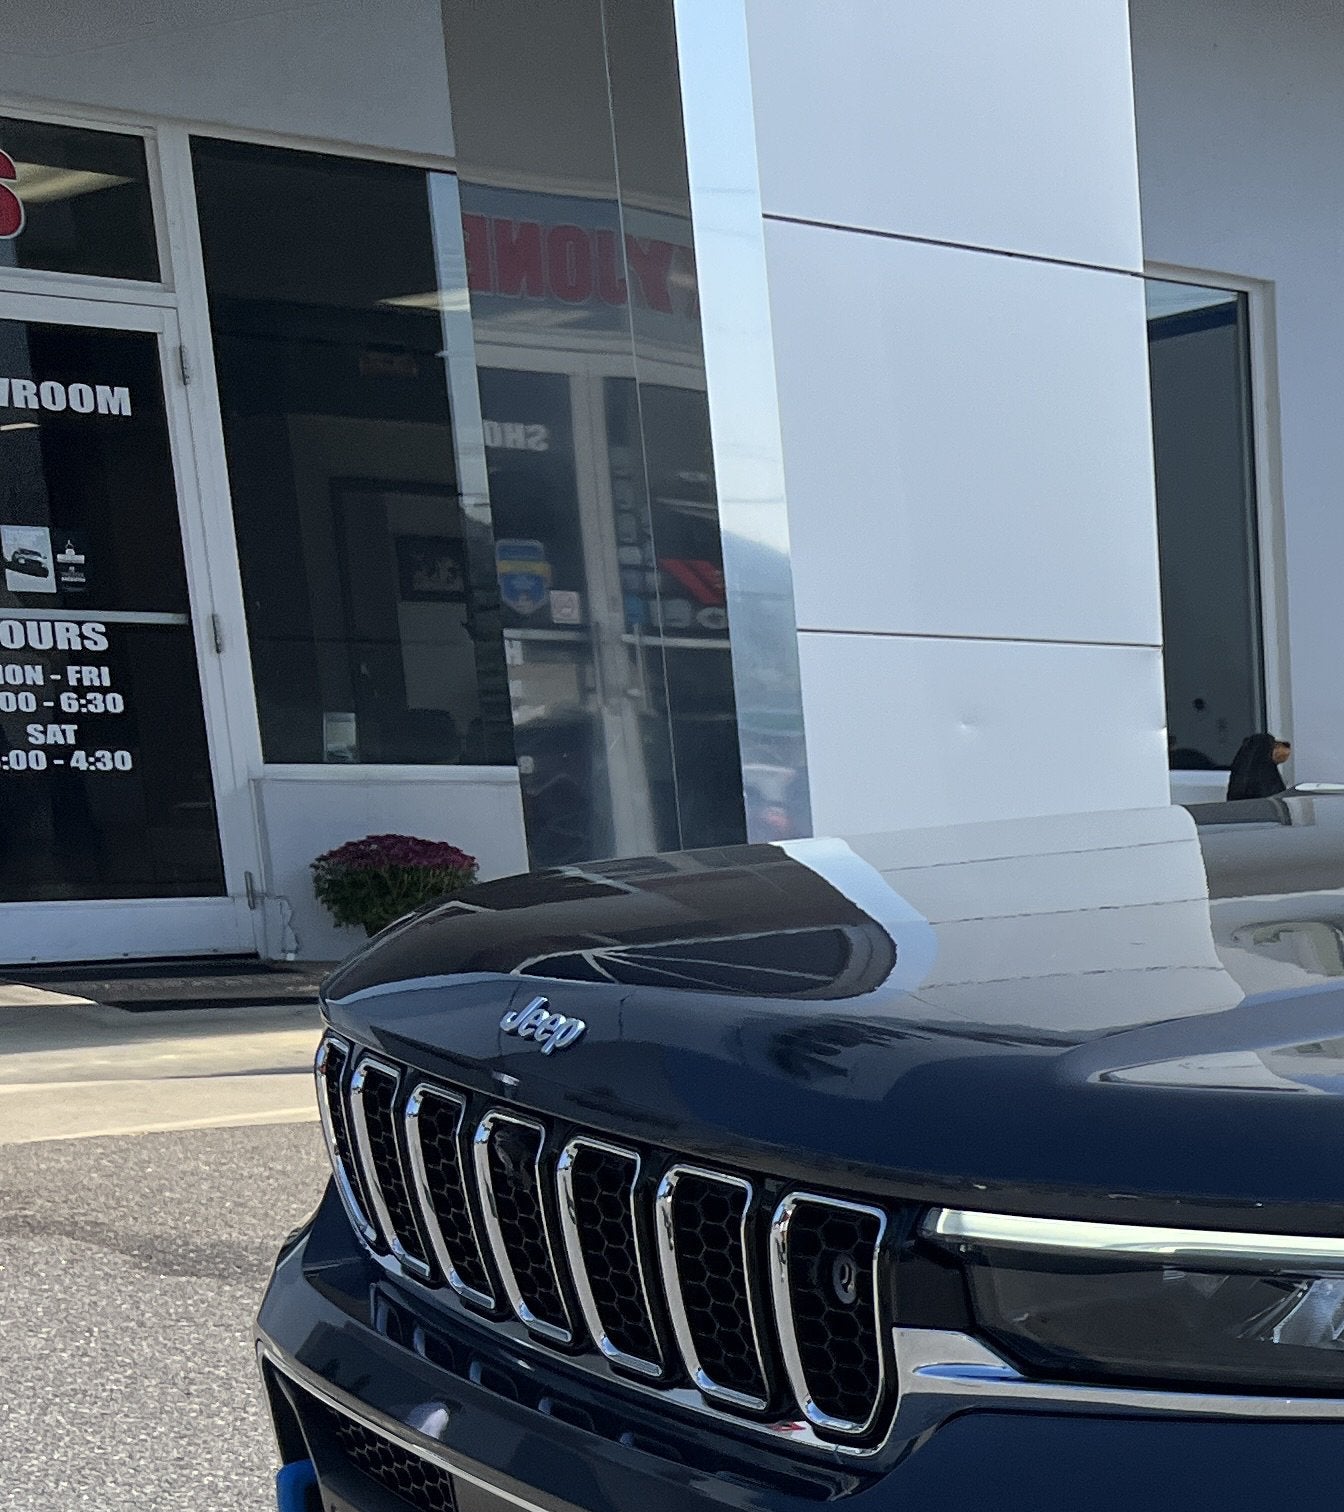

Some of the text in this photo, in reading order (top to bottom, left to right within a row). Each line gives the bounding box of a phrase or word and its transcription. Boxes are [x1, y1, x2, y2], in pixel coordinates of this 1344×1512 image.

[0, 377, 132, 416] ROOM
[0, 619, 109, 651] OURS
[0, 664, 45, 686] ON
[66, 665, 111, 687] FRI
[60, 692, 125, 713] 6:30
[26, 723, 78, 745] SAT
[0, 750, 47, 771] :00
[70, 750, 133, 771] 4:30
[500, 996, 586, 1055] Jeep
